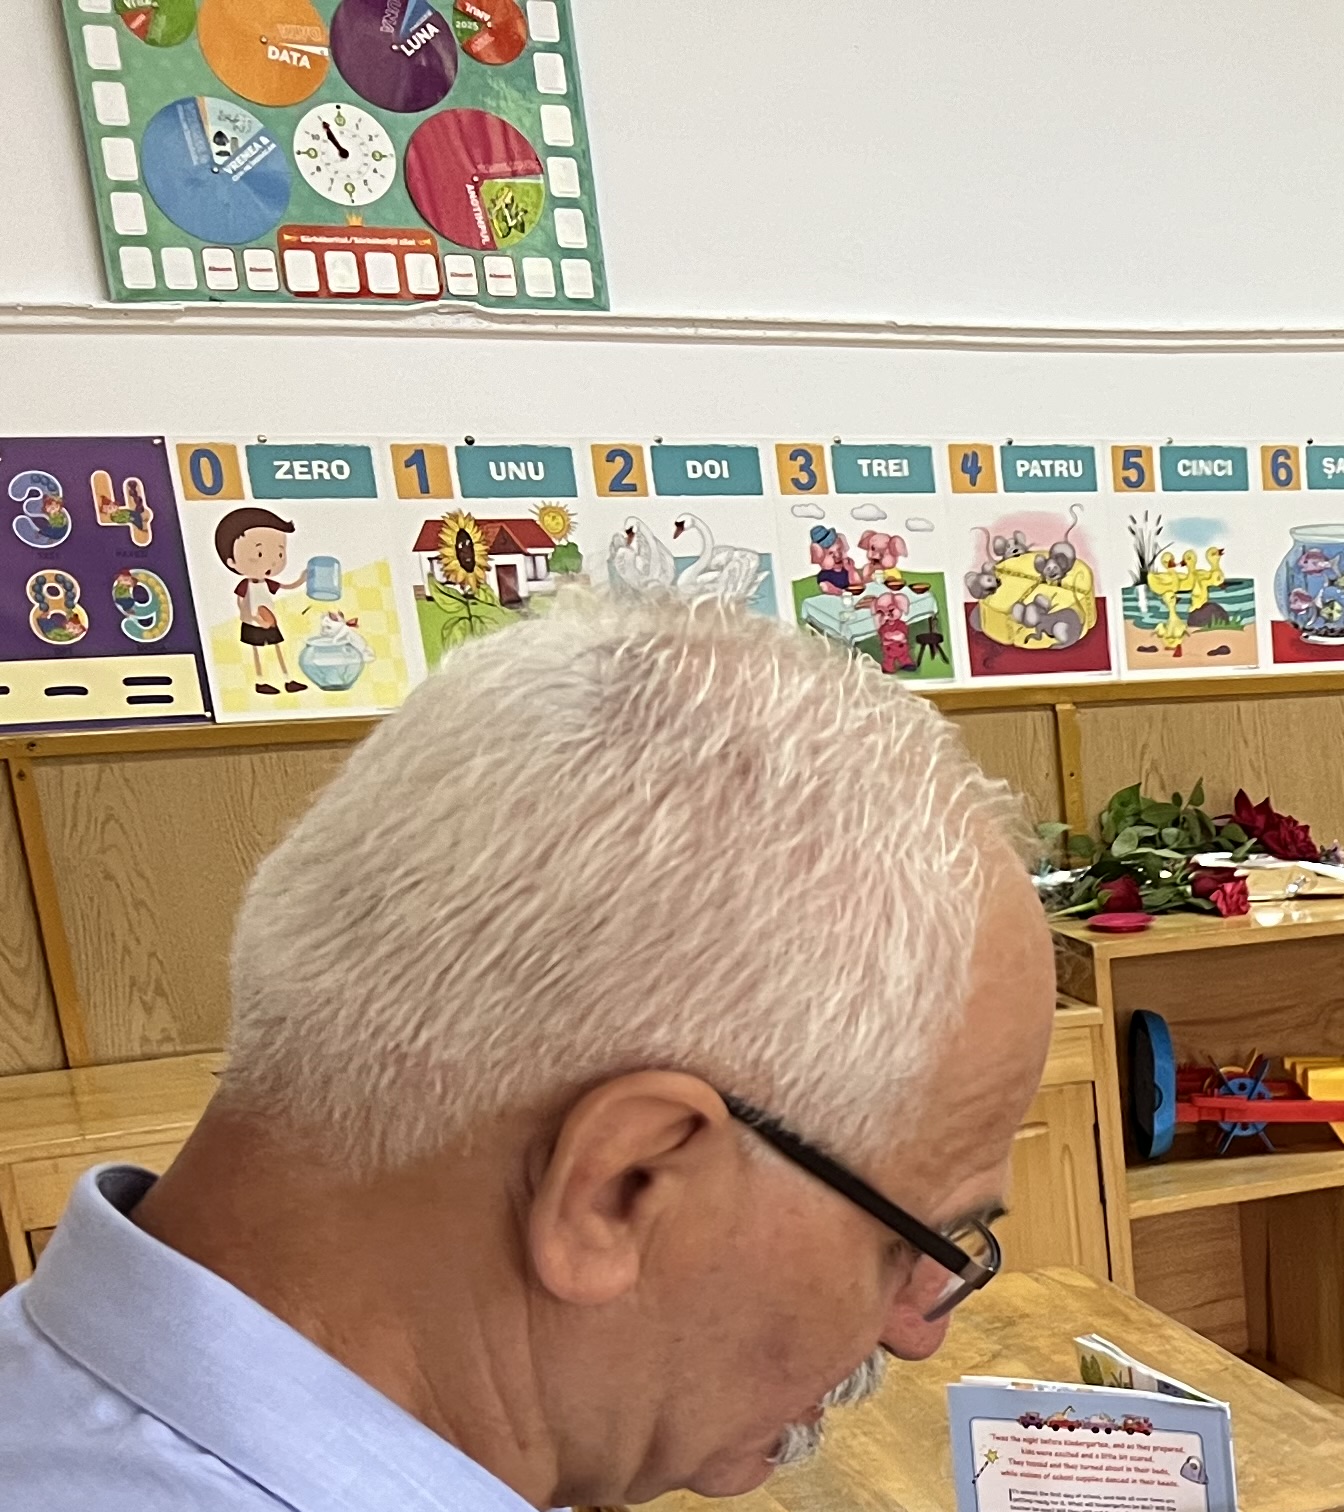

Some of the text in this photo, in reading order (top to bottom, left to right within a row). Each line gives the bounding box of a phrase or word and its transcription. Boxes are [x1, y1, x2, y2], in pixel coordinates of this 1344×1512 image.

[400, 22, 440, 57] LUNA
[455, 20, 480, 32] 2025
[266, 45, 312, 70] DATA
[189, 449, 351, 495] 0 ZERO
[404, 449, 544, 494] 1 UNU
[605, 449, 729, 492] 2 DOI
[790, 449, 910, 491] 3 TREI
[960, 451, 1083, 486] 4 PATRU
[1122, 449, 1233, 489] 5 CINCI
[1270, 449, 1293, 487] 6
[8, 469, 153, 548] 3 4
[26, 568, 173, 645] 8 9
